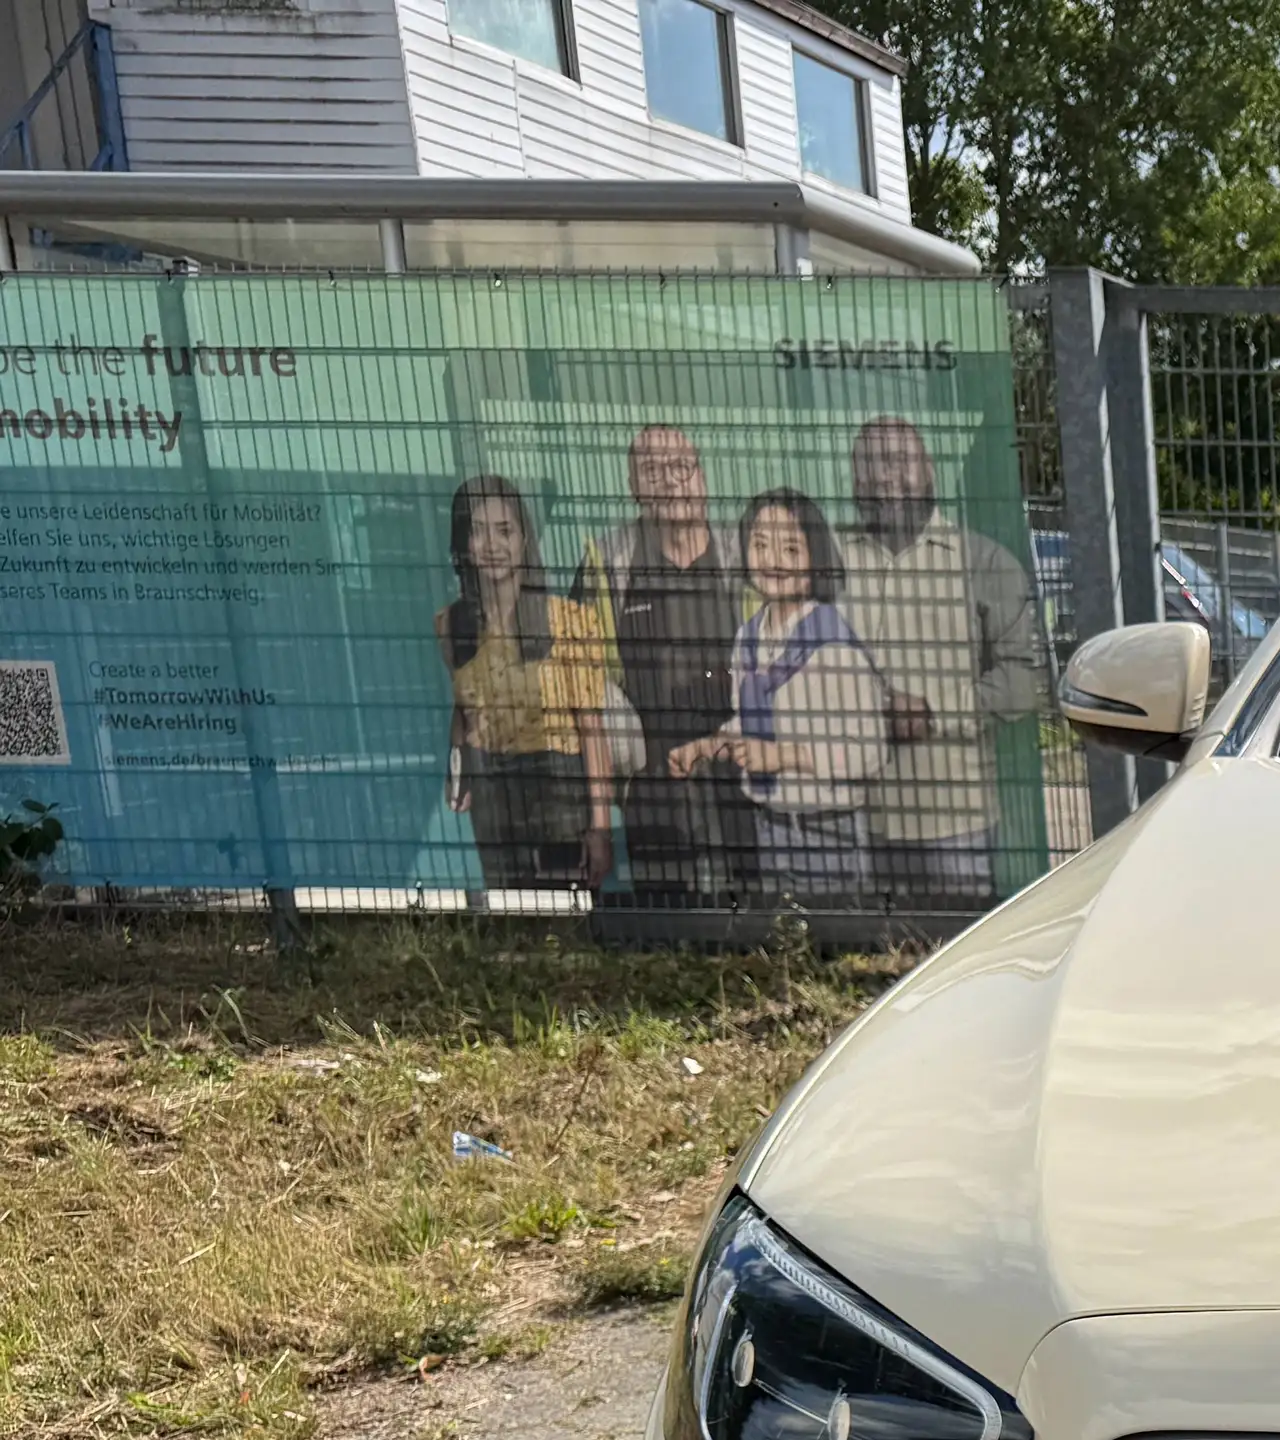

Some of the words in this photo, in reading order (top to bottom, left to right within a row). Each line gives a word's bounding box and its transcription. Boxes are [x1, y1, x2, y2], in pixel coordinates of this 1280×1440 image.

[55, 333, 126, 376] the
[142, 334, 297, 377] future
[774, 338, 957, 370] SIEMENS
[17, 505, 78, 520] unsere
[83, 502, 198, 522] Leidenschaft
[203, 503, 229, 522] für
[233, 503, 322, 522] Mobilität?
[45, 528, 73, 547] Sie
[79, 530, 117, 549] uns,
[122, 530, 198, 551] wichtige
[204, 530, 290, 552] Lösungen
[1, 555, 70, 574] Zukunft
[76, 560, 96, 573] zu
[102, 554, 198, 575] entwickeln
[205, 557, 239, 575] und
[244, 557, 311, 575] werden
[48, 582, 107, 600] Teams
[111, 581, 130, 600] in
[134, 582, 265, 606] Braunschweig.
[89, 660, 146, 679] Create
[151, 664, 162, 679] a
[166, 661, 220, 680] better
[94, 686, 277, 706] #TomorrowWithUs
[99, 712, 237, 735] #WeAreHiring
